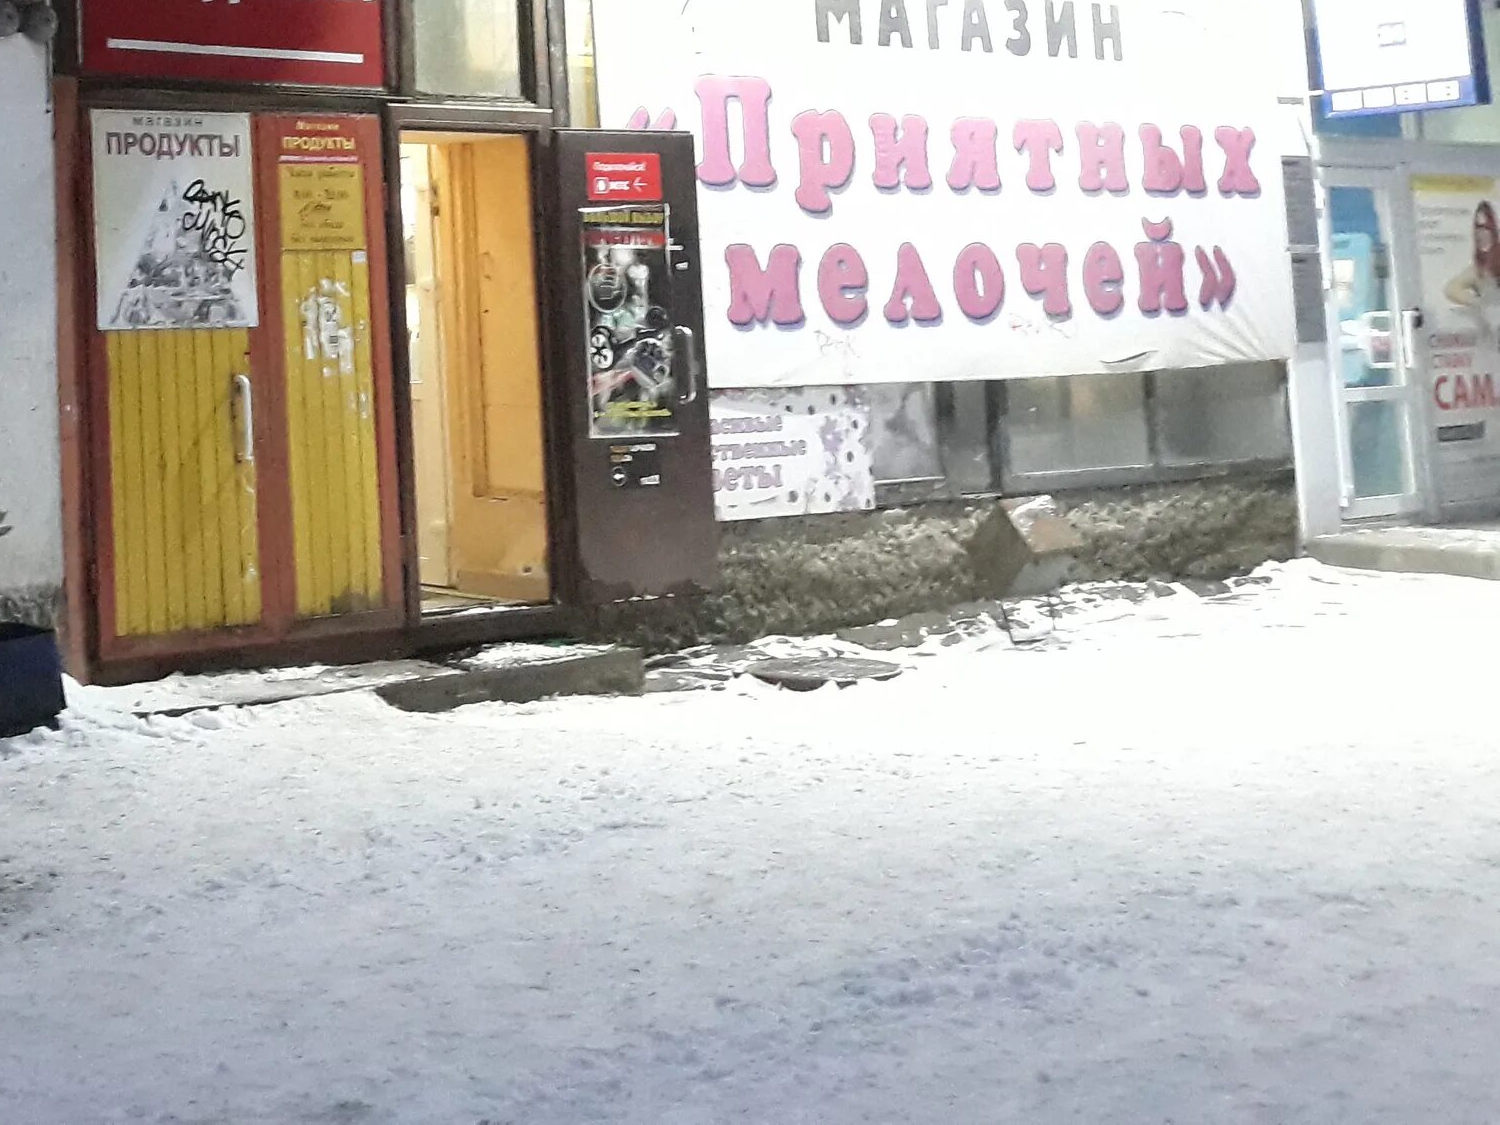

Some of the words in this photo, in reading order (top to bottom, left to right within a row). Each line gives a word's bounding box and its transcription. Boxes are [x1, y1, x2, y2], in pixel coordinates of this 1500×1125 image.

[105, 131, 241, 160] ПРОДУКТЫ
[281, 135, 357, 151] ПРОДУКТЫ
[724, 215, 1238, 328] мелочей»
